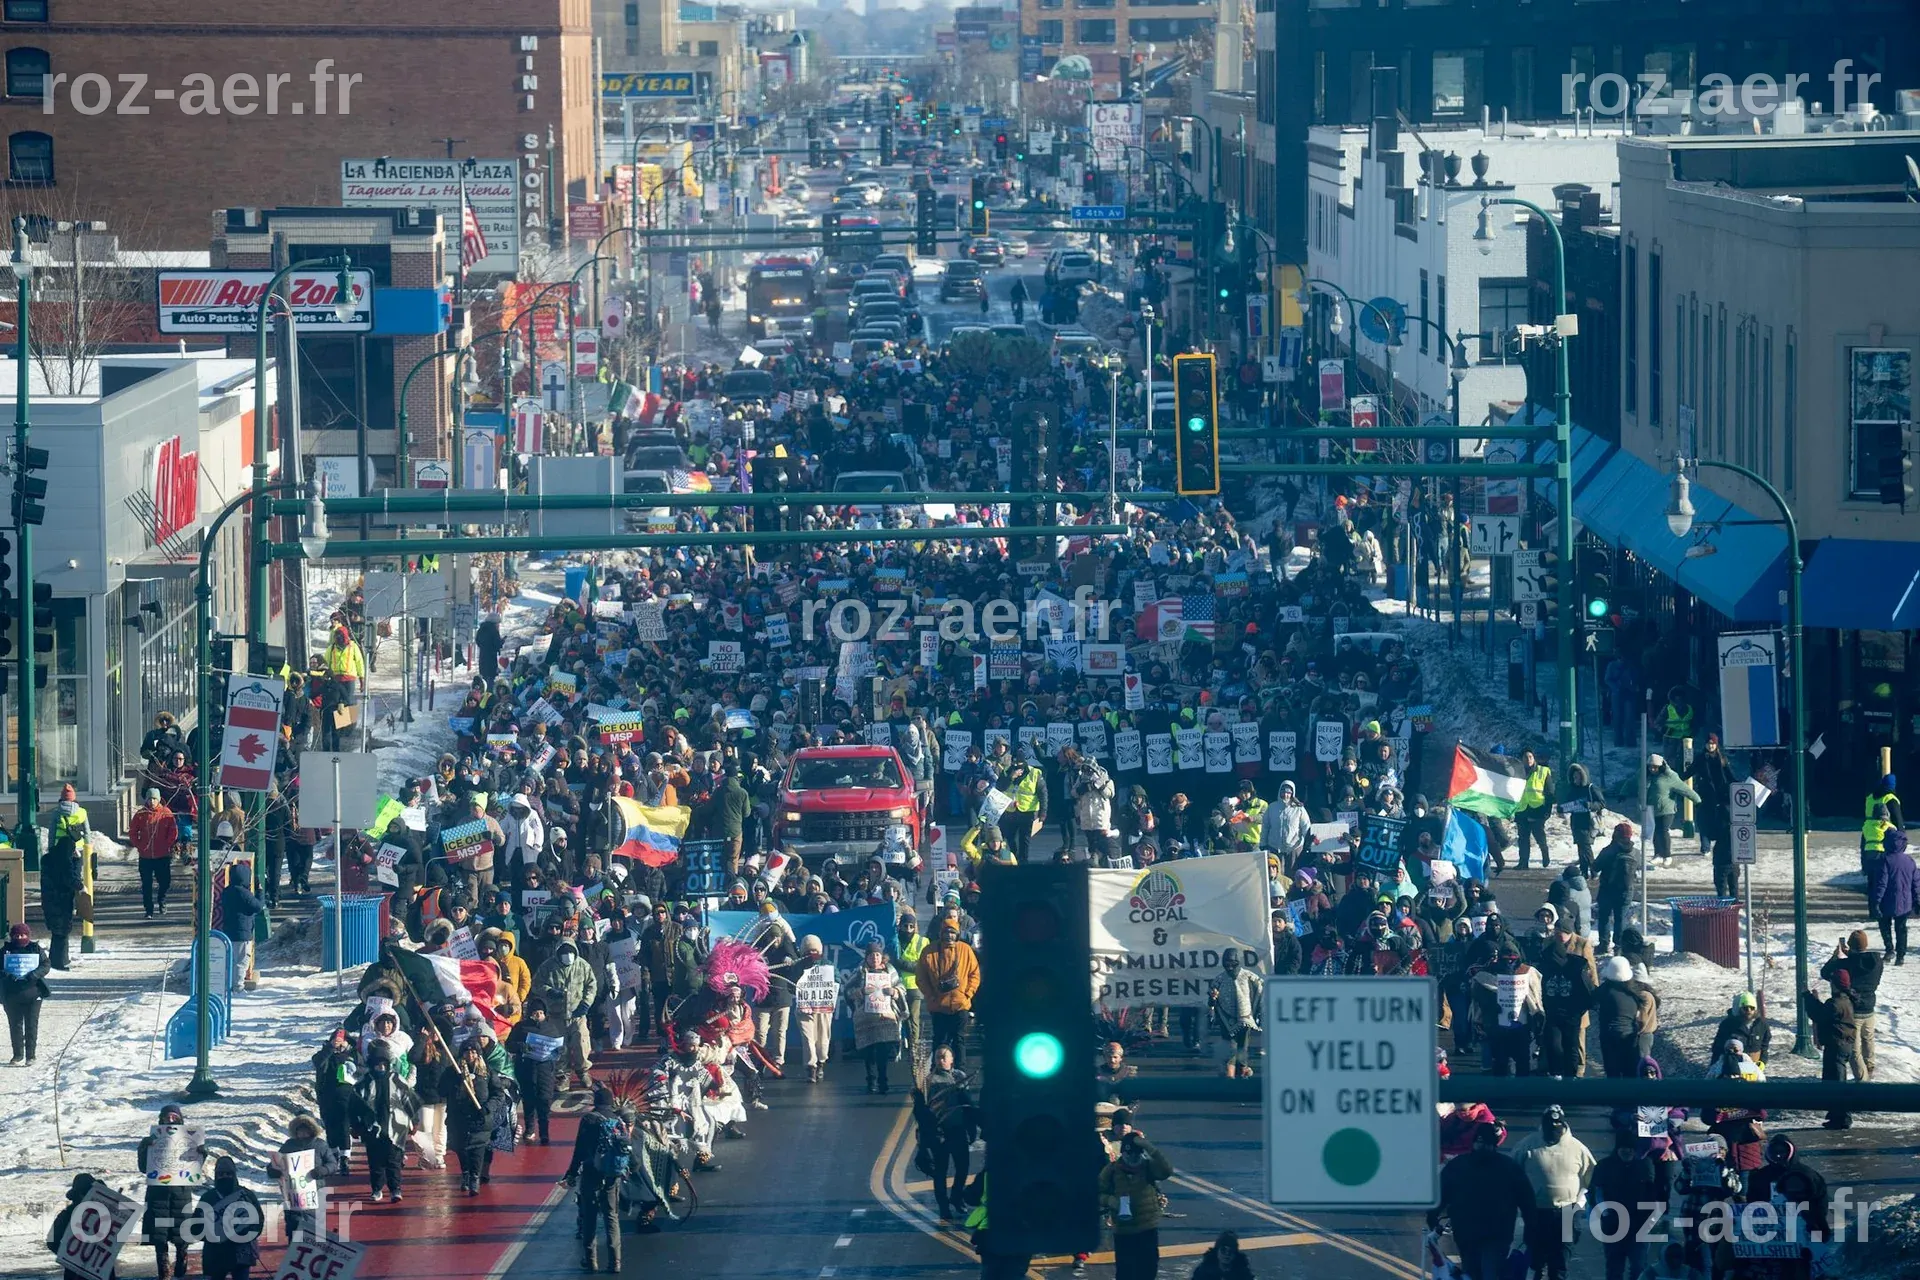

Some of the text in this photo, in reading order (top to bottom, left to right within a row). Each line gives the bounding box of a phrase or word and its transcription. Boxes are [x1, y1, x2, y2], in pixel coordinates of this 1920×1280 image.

[521, 36, 538, 109] MINI
[600, 75, 690, 93] ODYEAR
[462, 165, 513, 180] PLAZA
[347, 185, 513, 199] Taqueria La Hacienda
[524, 134, 541, 246] STORAG
[214, 279, 362, 306] AutZon
[179, 314, 206, 323] Auto
[209, 314, 239, 323] Parts
[322, 460, 339, 470] We
[719, 644, 733, 653] NO
[619, 722, 640, 731] OUT
[1233, 726, 1258, 734] DEFEND
[609, 732, 633, 742] MSP
[946, 734, 971, 743] DEFEND
[1116, 734, 1139, 743] DEFEND
[1178, 732, 1201, 740] DEFEND
[1208, 736, 1229, 744] EFEND
[444, 834, 482, 852] ICE OU
[1364, 826, 1401, 850] ICE
[382, 848, 399, 858] ICE
[457, 844, 482, 859] MSP
[1360, 844, 1400, 866] OUT!
[687, 852, 722, 871] ICE
[1112, 859, 1131, 869] WAR
[687, 873, 725, 891] OUT!
[528, 897, 545, 905] ICE
[1129, 907, 1188, 923] COPAL
[1153, 927, 1168, 946] &
[1090, 950, 1259, 973] OMMUNIDD
[810, 965, 819, 976] NO
[798, 989, 811, 1000] NO
[818, 989, 834, 1000] LAS
[1099, 978, 1216, 1000] PRESENT
[1277, 997, 1424, 1022] LEFT TURN
[1305, 1040, 1395, 1071] YIELD
[1280, 1088, 1423, 1114] ON GREEN
[1688, 1143, 1717, 1153] WE ARE
[74, 1208, 123, 1247] ICE
[66, 1233, 112, 1274] OUT!
[290, 1245, 344, 1280] ICE
